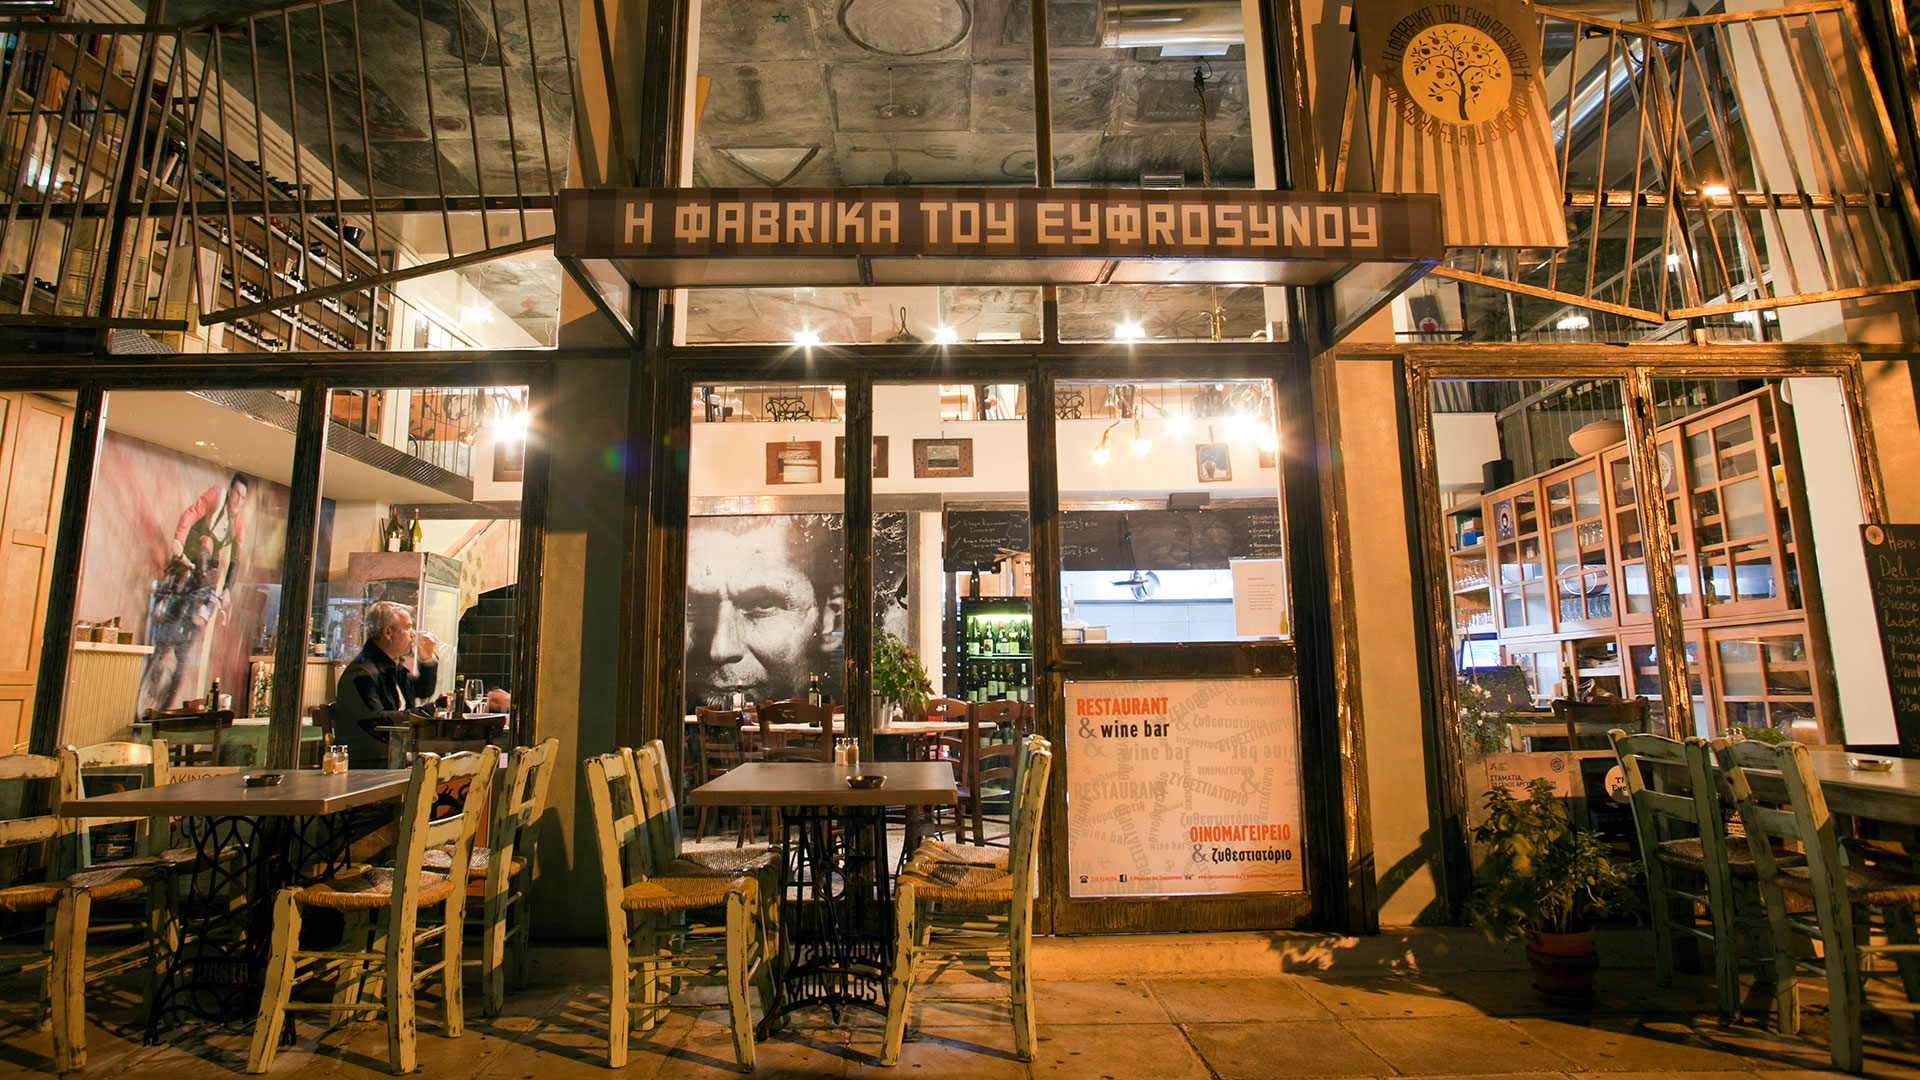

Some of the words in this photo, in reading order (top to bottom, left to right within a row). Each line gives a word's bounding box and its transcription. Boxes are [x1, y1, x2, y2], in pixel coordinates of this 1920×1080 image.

[624, 202, 653, 243] Η
[1077, 697, 1168, 716] RESTAURANT
[1078, 717, 1097, 738] &
[1100, 720, 1138, 738] wine
[1143, 718, 1169, 738] bar
[1190, 823, 1291, 843] ΟΙΝΟΜΑΓΕΙΡΕΙΟ
[1191, 843, 1209, 863] &
[1211, 845, 1292, 865] ζυθεστιατόριο
